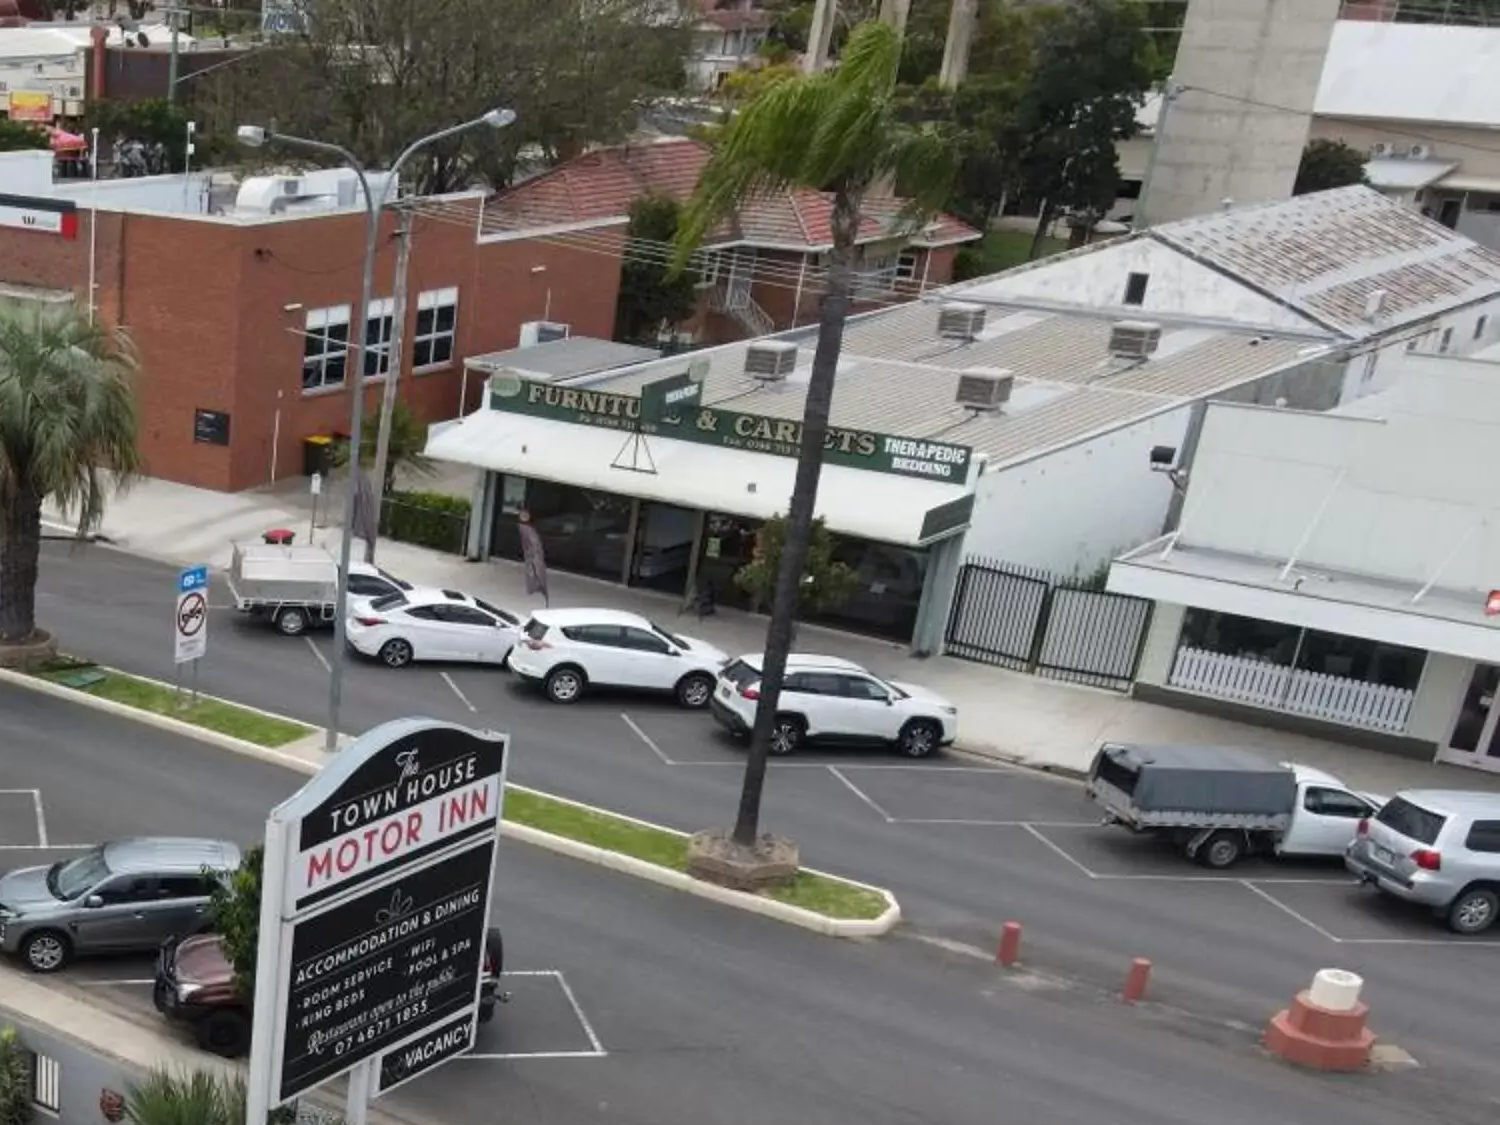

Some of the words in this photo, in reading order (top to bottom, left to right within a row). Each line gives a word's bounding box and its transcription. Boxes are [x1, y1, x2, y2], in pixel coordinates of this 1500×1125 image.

[696, 410, 718, 431] &
[329, 787, 399, 833] TOWN
[405, 757, 479, 803] HOUSE
[306, 811, 424, 888] MOTOR
[438, 784, 490, 834] INN
[294, 914, 420, 984] ACCOMMODATION
[422, 911, 431, 926] &
[434, 888, 481, 921] DINING
[342, 957, 393, 990] SERVICE
[334, 1035, 354, 1056] 07
[404, 1021, 473, 1068] VACANCY
